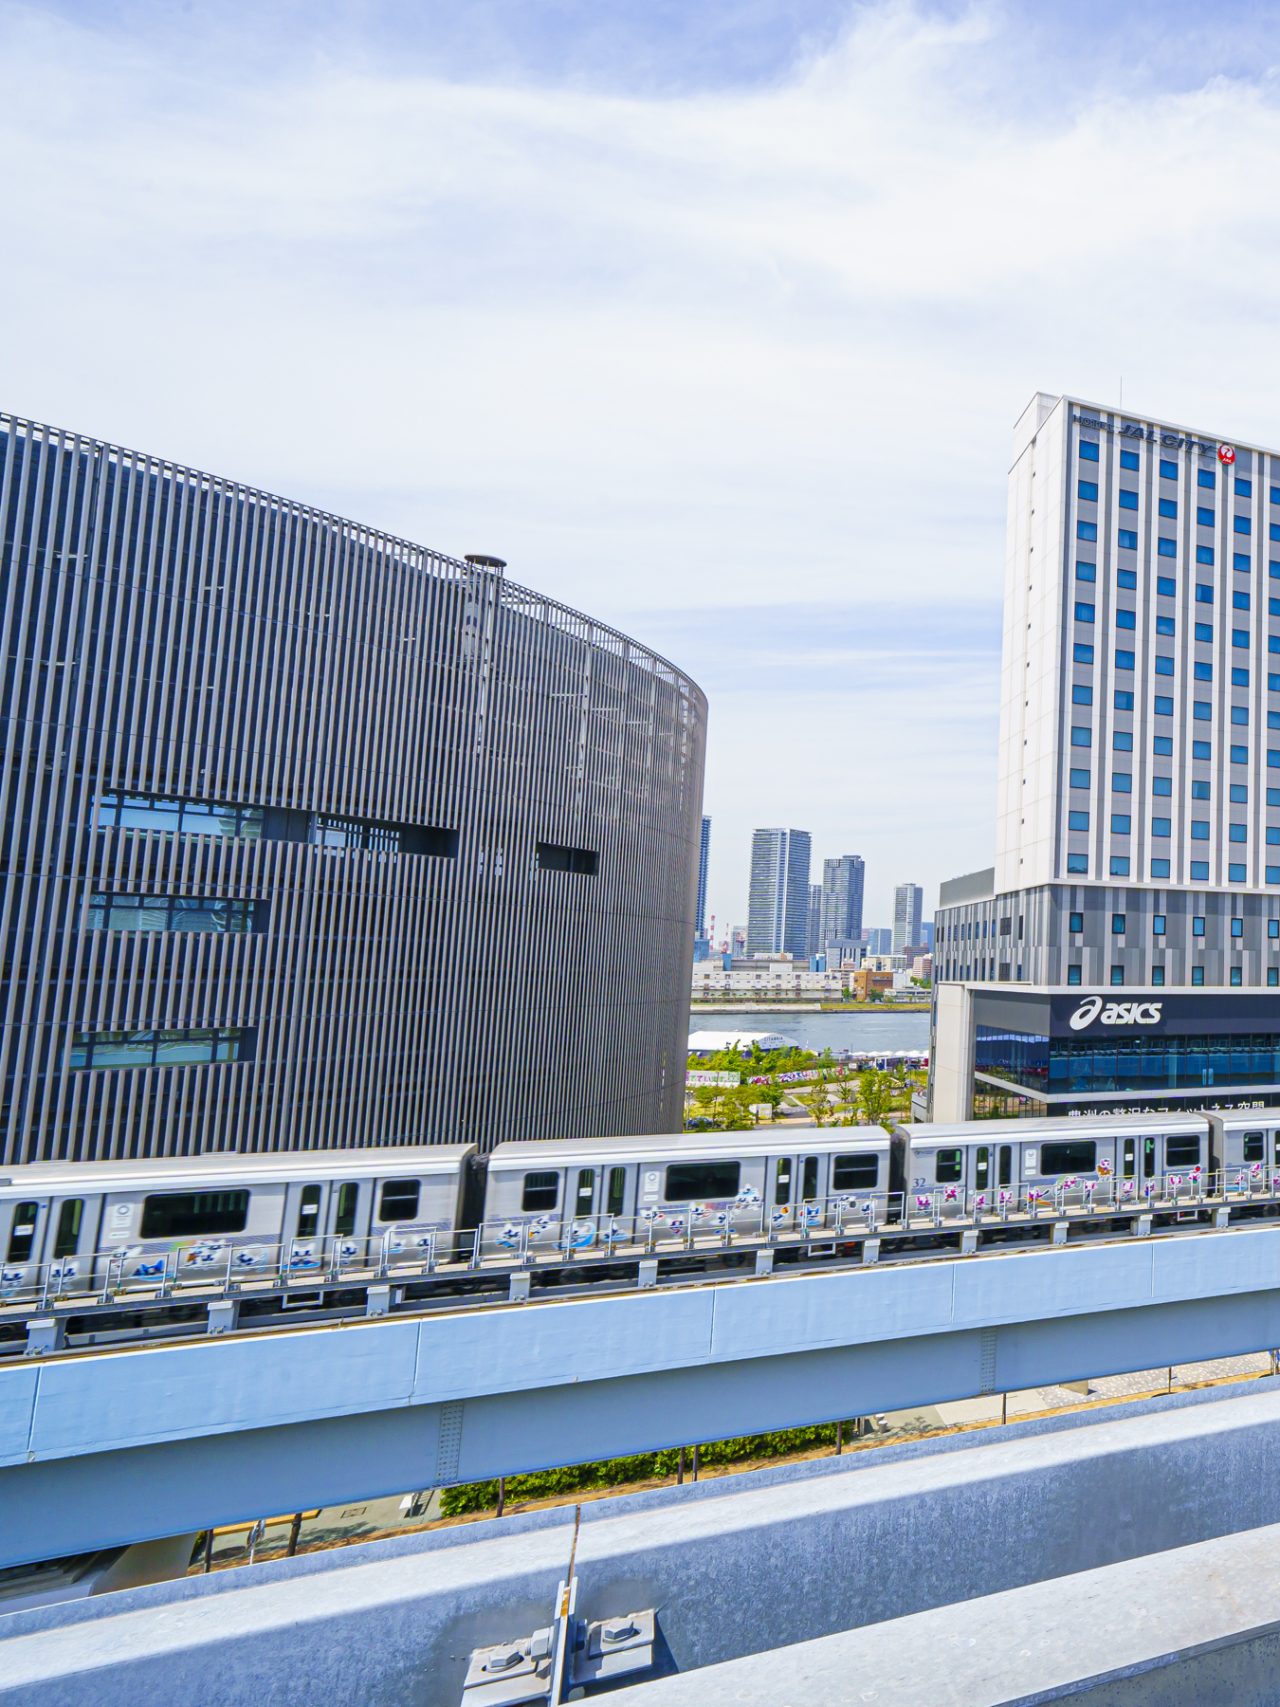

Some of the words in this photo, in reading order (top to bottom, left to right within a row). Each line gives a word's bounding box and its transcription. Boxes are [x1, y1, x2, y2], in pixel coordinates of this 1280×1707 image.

[1118, 424, 1158, 442] JAL
[1160, 434, 1214, 456] CITY
[1100, 1002, 1163, 1025] asics
[912, 1177, 927, 1188] 32
